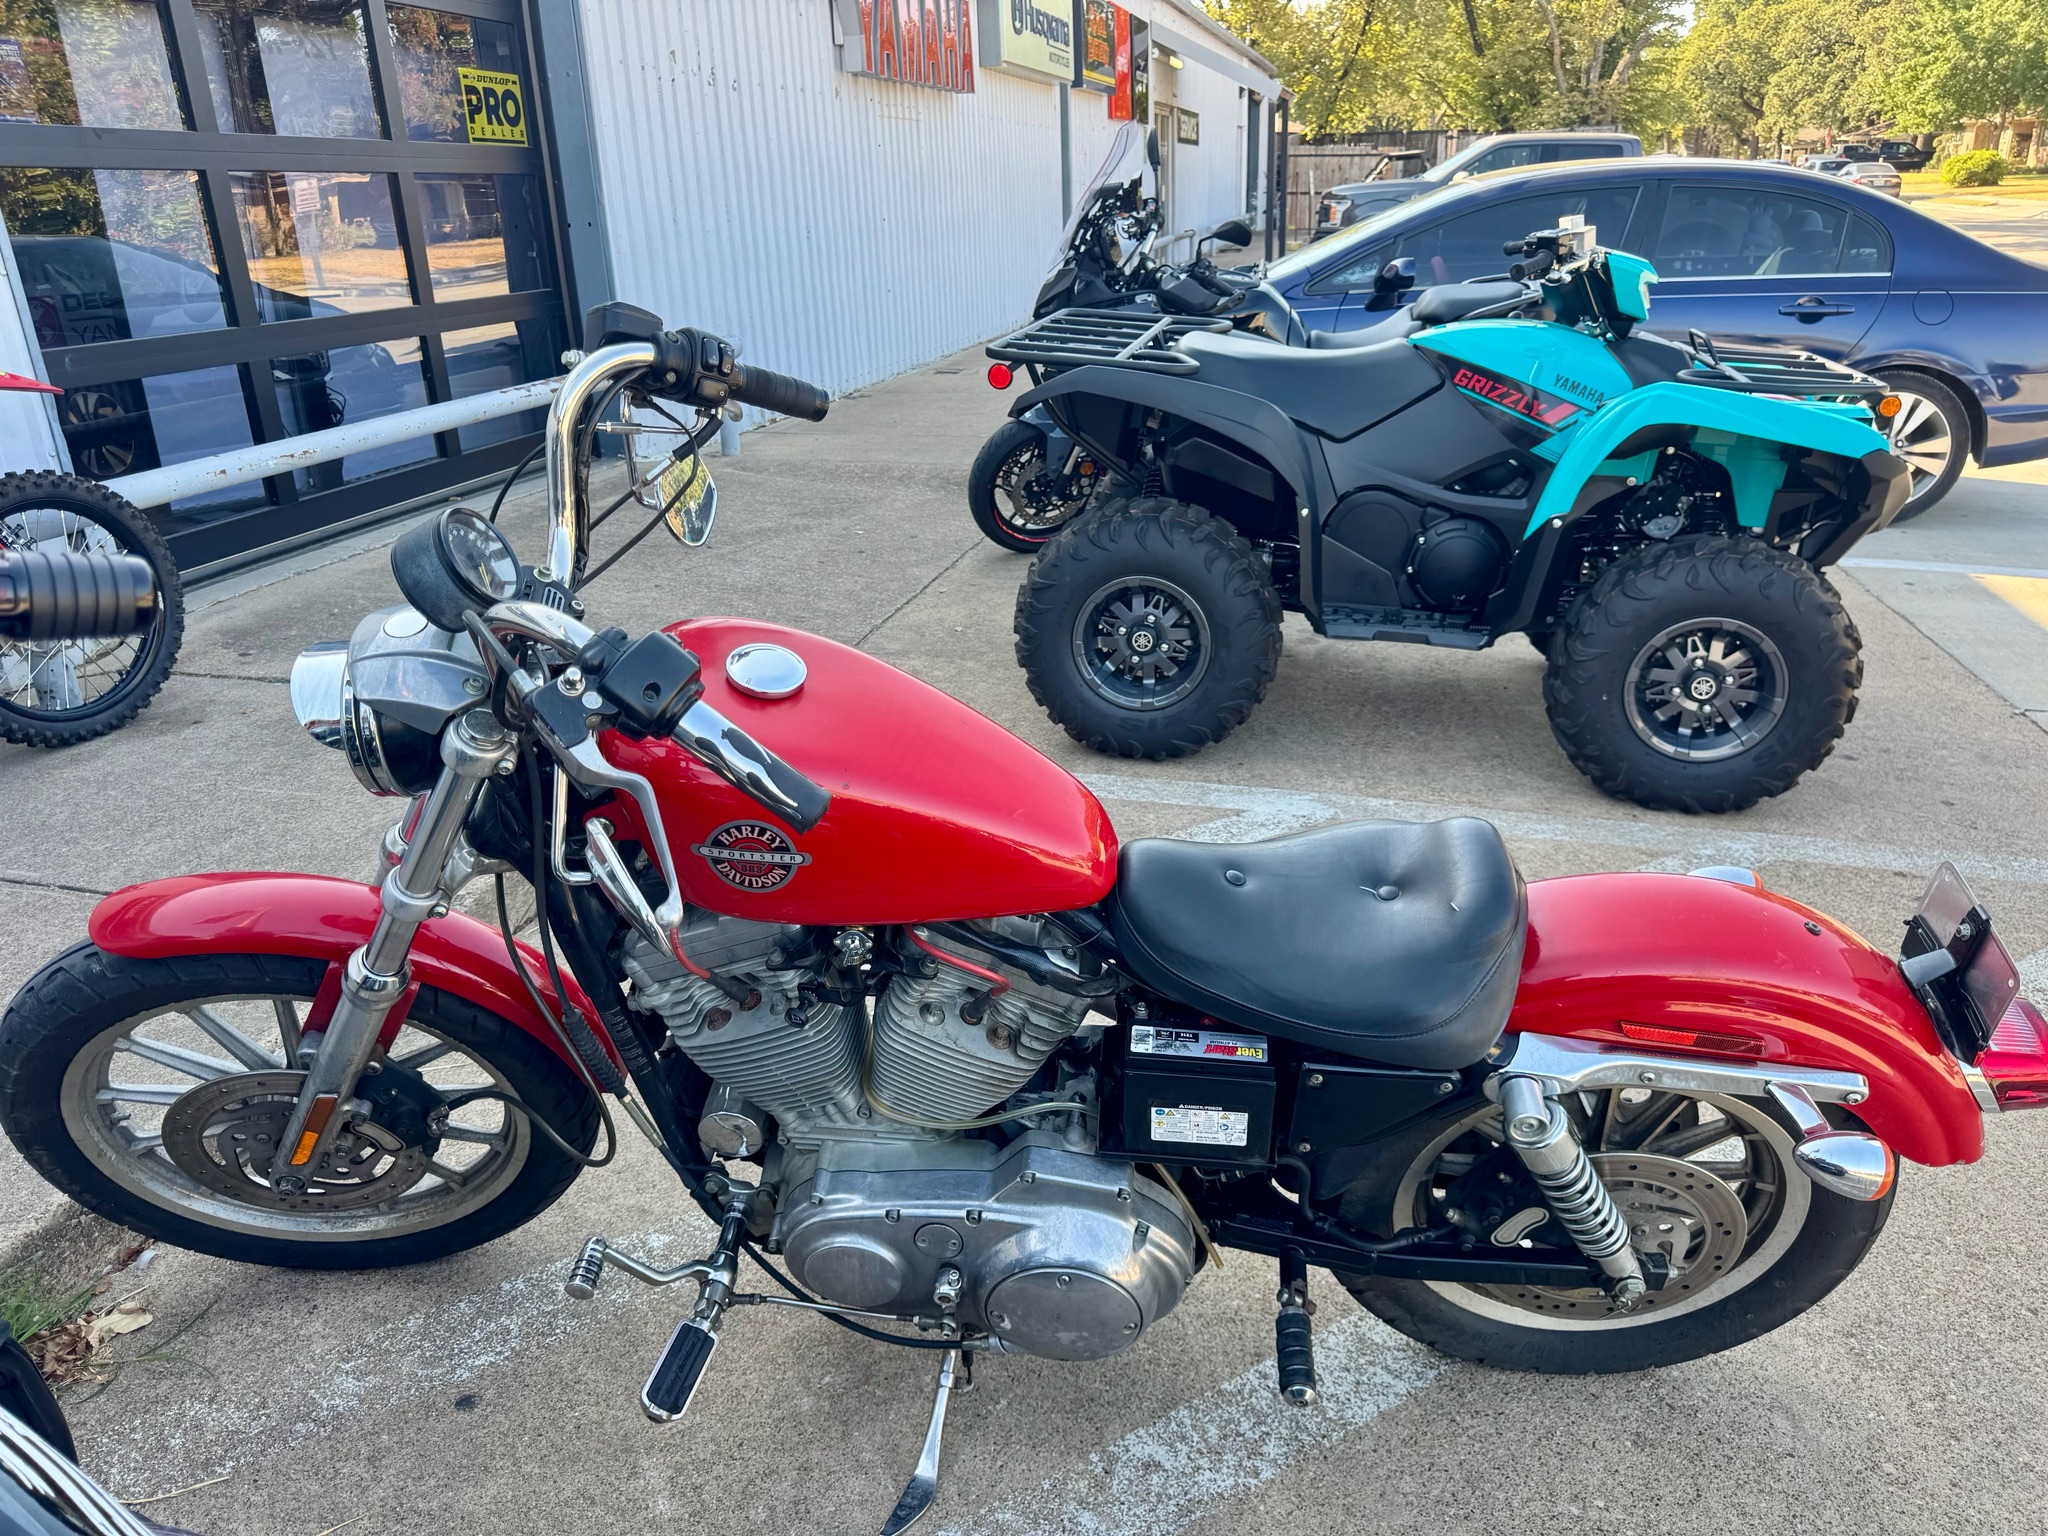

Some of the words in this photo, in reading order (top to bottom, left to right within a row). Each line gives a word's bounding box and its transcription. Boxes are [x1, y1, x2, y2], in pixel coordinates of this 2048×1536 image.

[1025, 0, 1070, 48] Husqvarna
[860, 0, 975, 93] YAMAHA
[476, 75, 511, 85] DUNLOP
[464, 84, 521, 128] PRO
[470, 126, 525, 138] DEALER
[1453, 368, 1547, 418] GRIZZLY
[1553, 374, 1605, 405] YAMAHA
[717, 825, 787, 849] HARLEY
[707, 848, 797, 863] SPORTSTER
[716, 861, 788, 888] DAVIDSON
[739, 864, 764, 874] 883
[1205, 1044, 1263, 1059] EverStart
